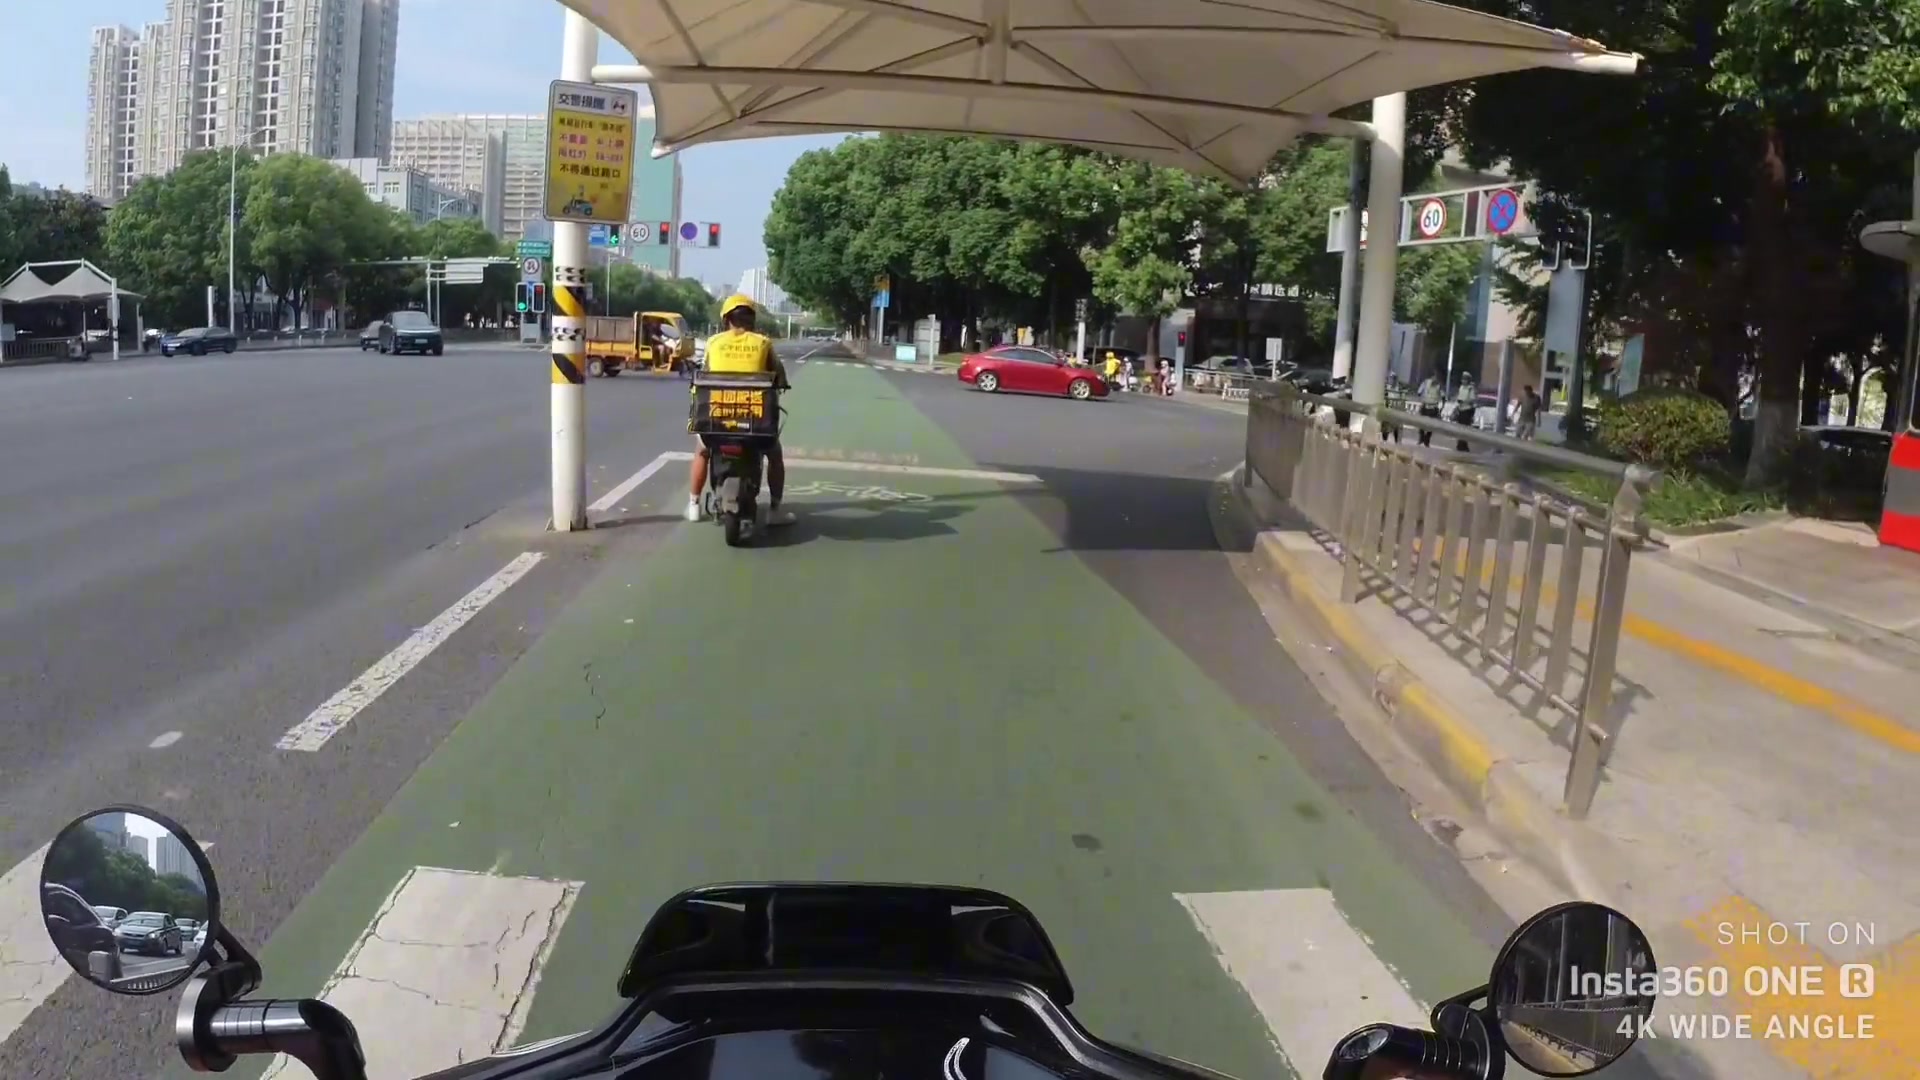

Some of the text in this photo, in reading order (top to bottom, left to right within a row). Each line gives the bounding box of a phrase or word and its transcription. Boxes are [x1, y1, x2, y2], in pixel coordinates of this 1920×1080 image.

[559, 163, 621, 178] 不得通过路口
[1423, 208, 1440, 228] 60
[633, 227, 646, 238] 60
